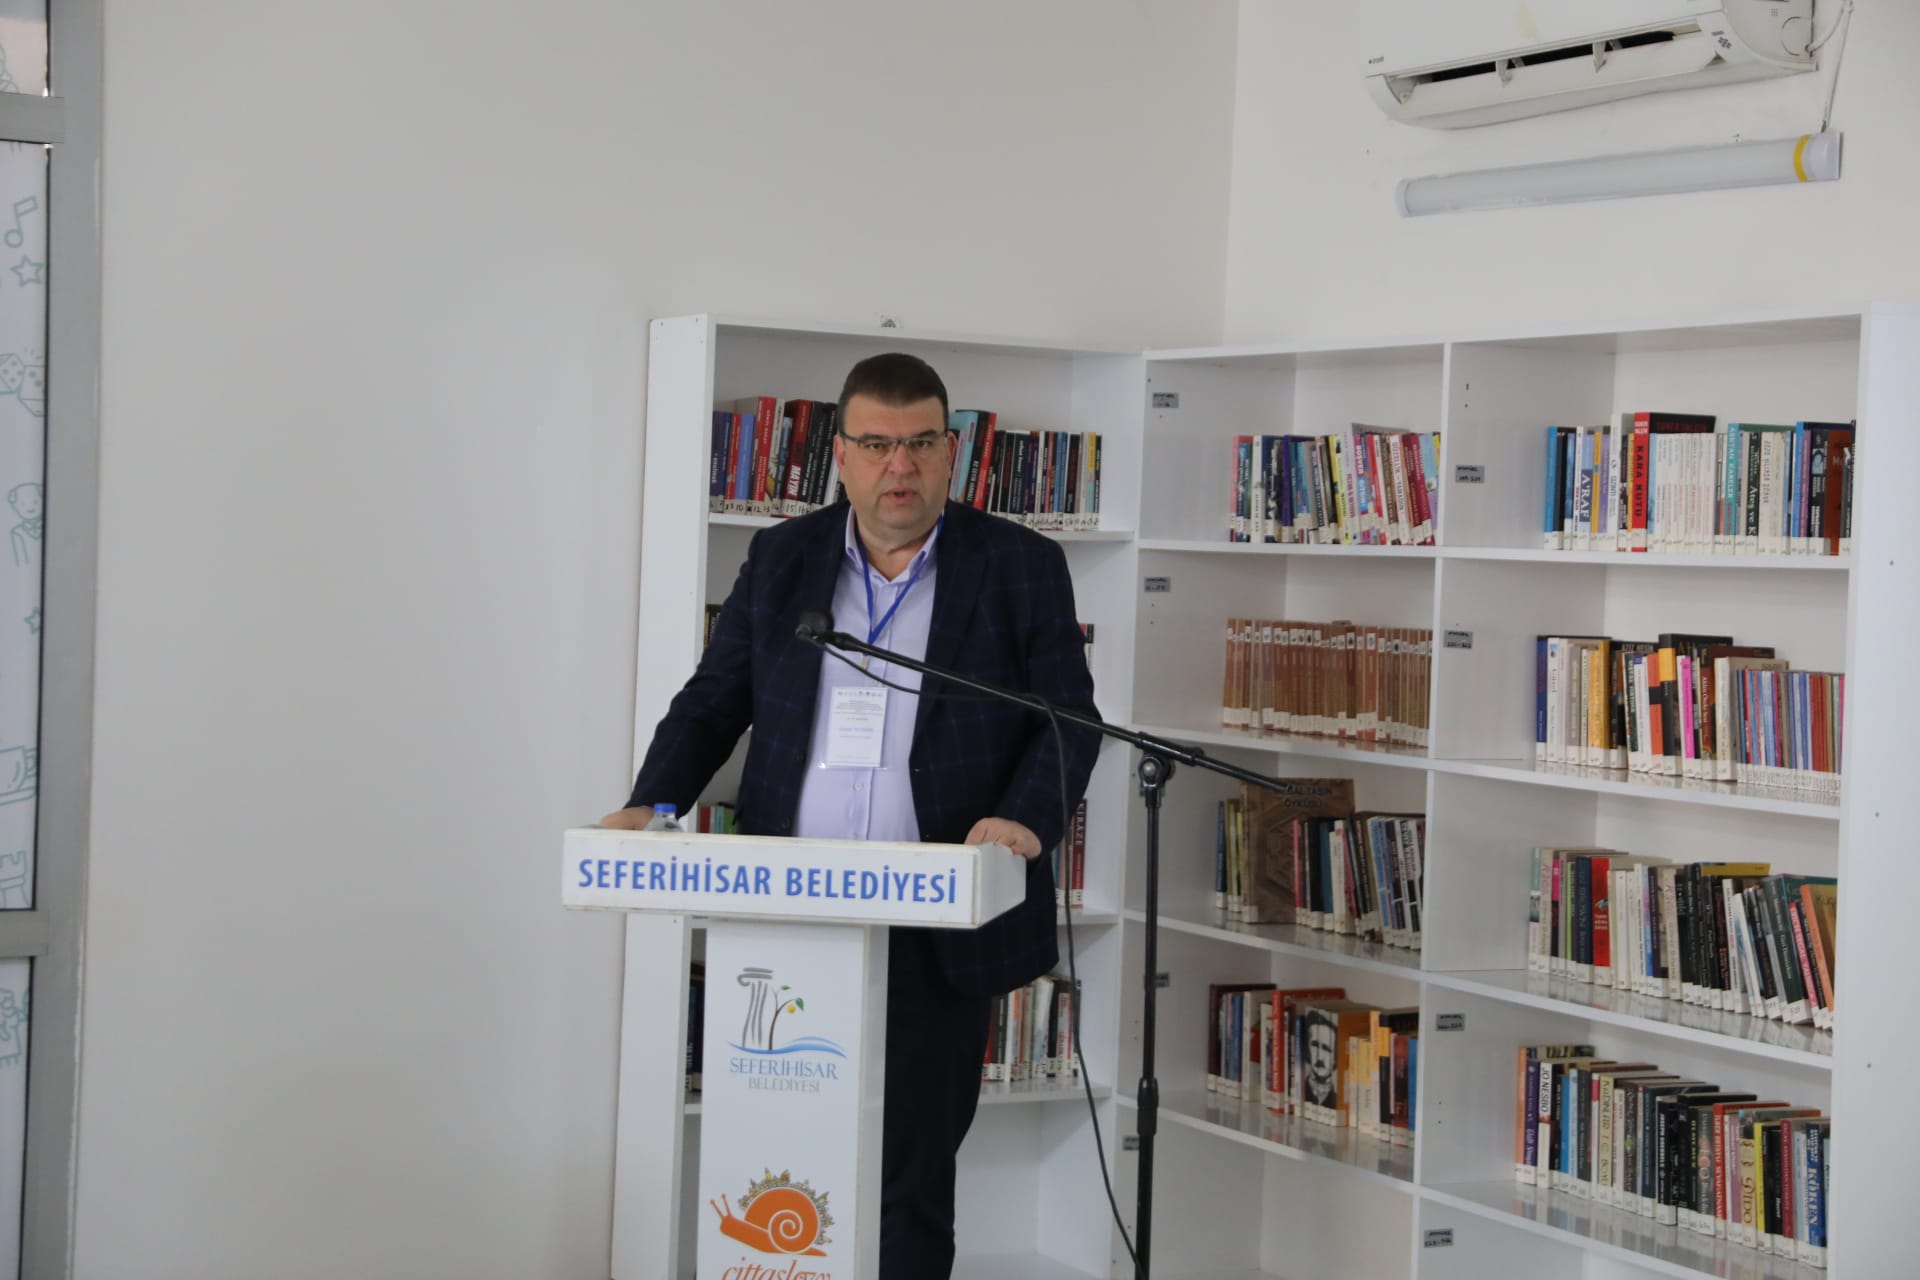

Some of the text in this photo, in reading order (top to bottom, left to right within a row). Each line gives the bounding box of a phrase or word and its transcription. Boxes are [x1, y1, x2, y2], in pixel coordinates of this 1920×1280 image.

[1580, 473, 1591, 519] A'RAF
[1635, 445, 1644, 518] KARA KUTU
[578, 856, 957, 904] SEFERİHİSAR BELEDİYESİ
[729, 1057, 838, 1080] SEFERİHİSAR
[1542, 1067, 1550, 1080] JO
